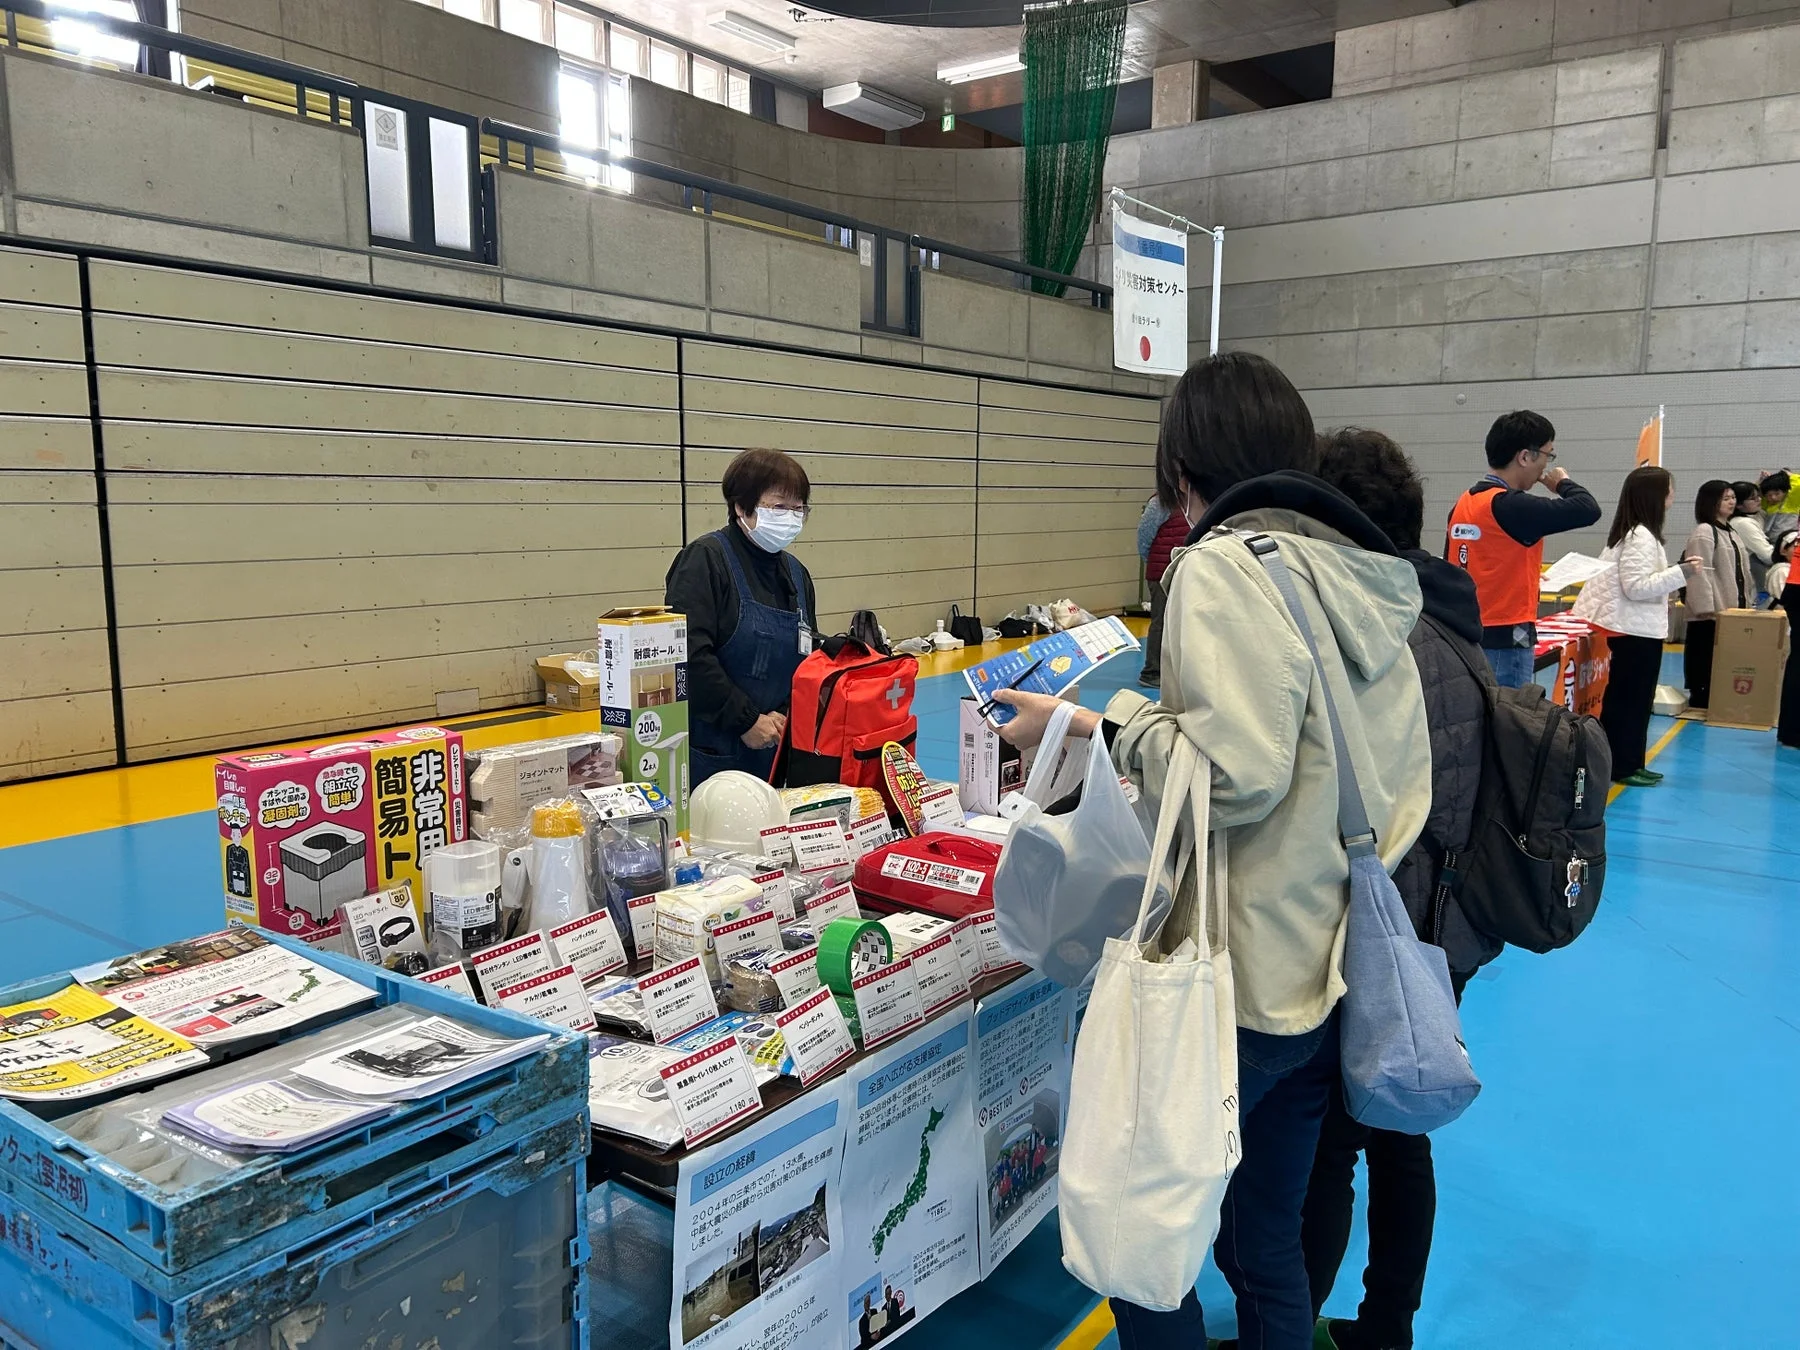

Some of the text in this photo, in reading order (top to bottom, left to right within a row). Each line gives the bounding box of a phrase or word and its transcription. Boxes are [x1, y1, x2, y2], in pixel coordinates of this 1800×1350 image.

[633, 646, 676, 660] 耐震ポール
[604, 638, 614, 692] 耐震ポール
[677, 667, 687, 698] 防災
[603, 708, 627, 725] 防災
[638, 720, 661, 735] 200kg
[519, 766, 565, 780] ジョイントマット
[642, 758, 657, 772] 2本入
[323, 775, 360, 795] 組立て
[261, 792, 307, 808] すばやく固める
[327, 789, 358, 809] 簡単！
[375, 756, 411, 880] 簡易ト
[265, 870, 279, 880] 32
[393, 893, 405, 903] 80
[291, 914, 302, 924] 31
[868, 1042, 943, 1097] 全国へ広がる支援協定
[728, 1099, 746, 1115] 1,180
[989, 1095, 1013, 1121] BEST 100
[703, 1150, 757, 1190] 設立の経緯
[691, 1229, 725, 1251] しました。
